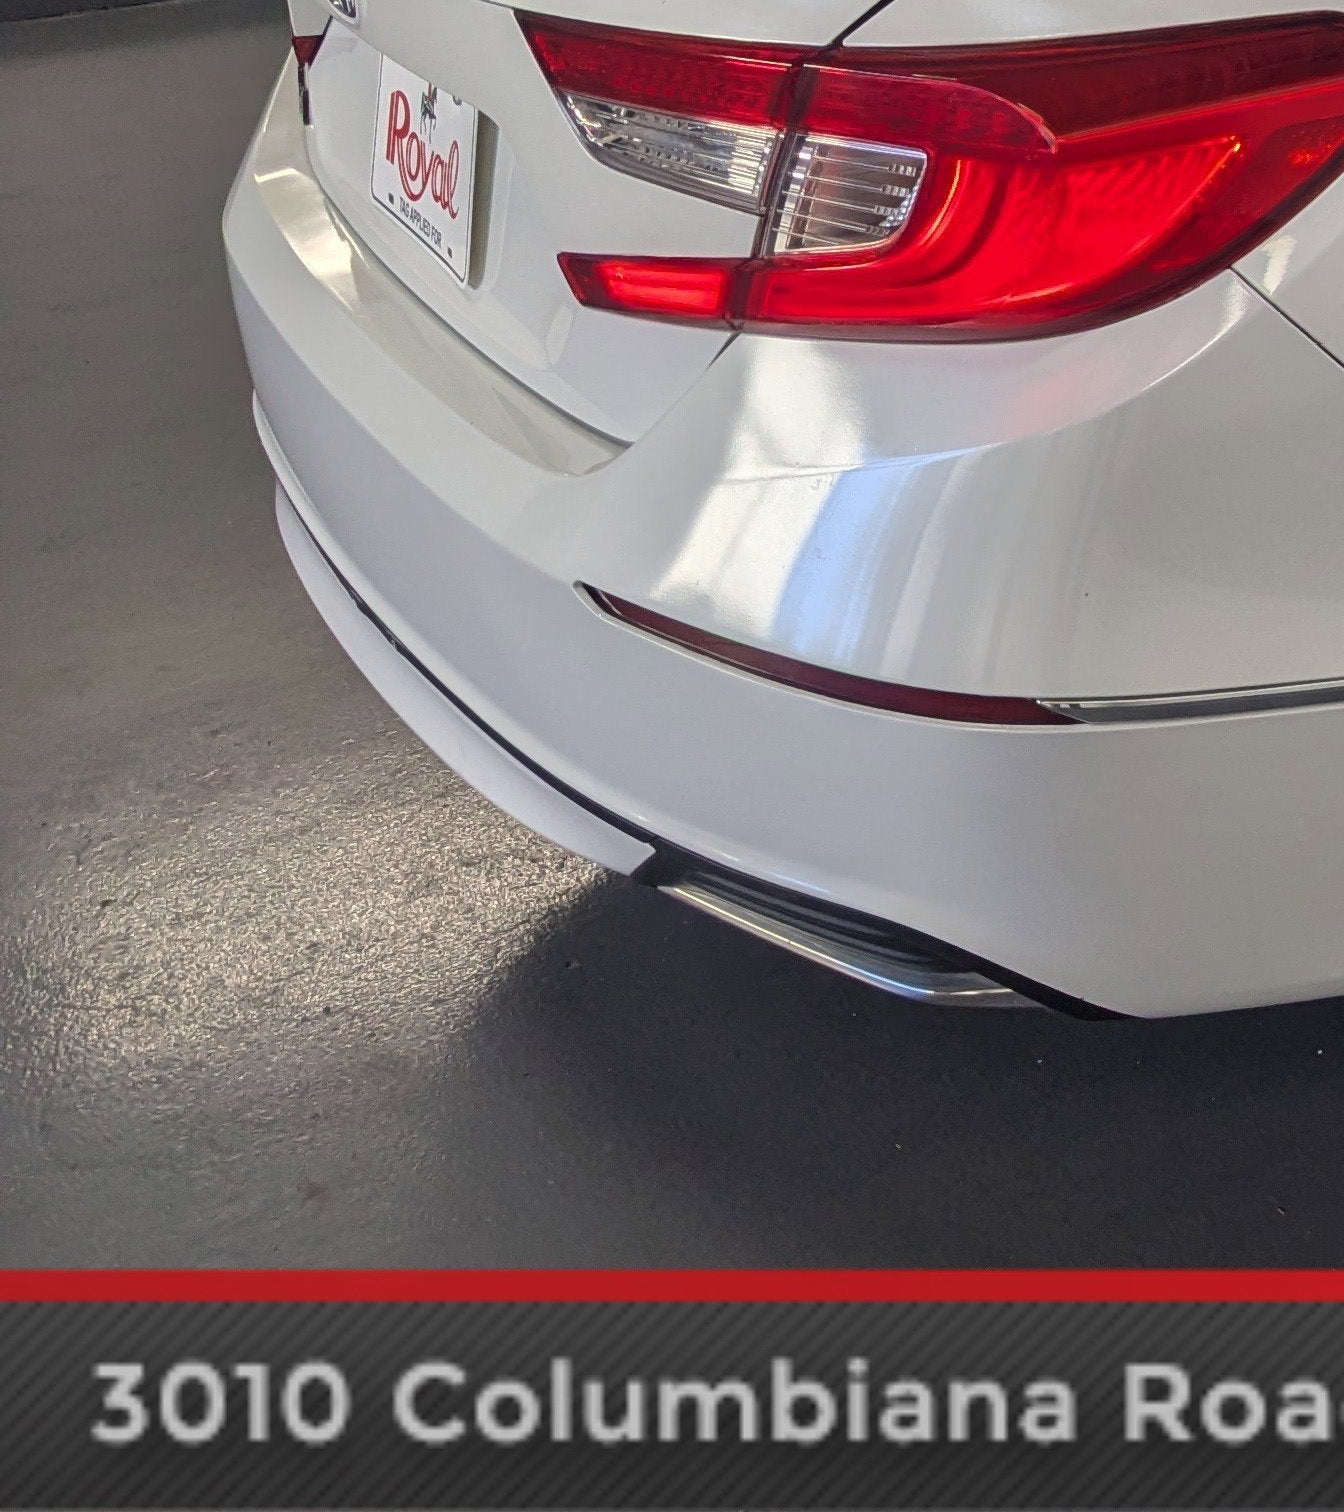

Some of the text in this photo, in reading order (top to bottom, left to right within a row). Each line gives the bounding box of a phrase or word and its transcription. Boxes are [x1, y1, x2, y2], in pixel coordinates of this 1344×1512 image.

[386, 90, 460, 220] Royal
[399, 196, 442, 249] TAG APPLIED FOR
